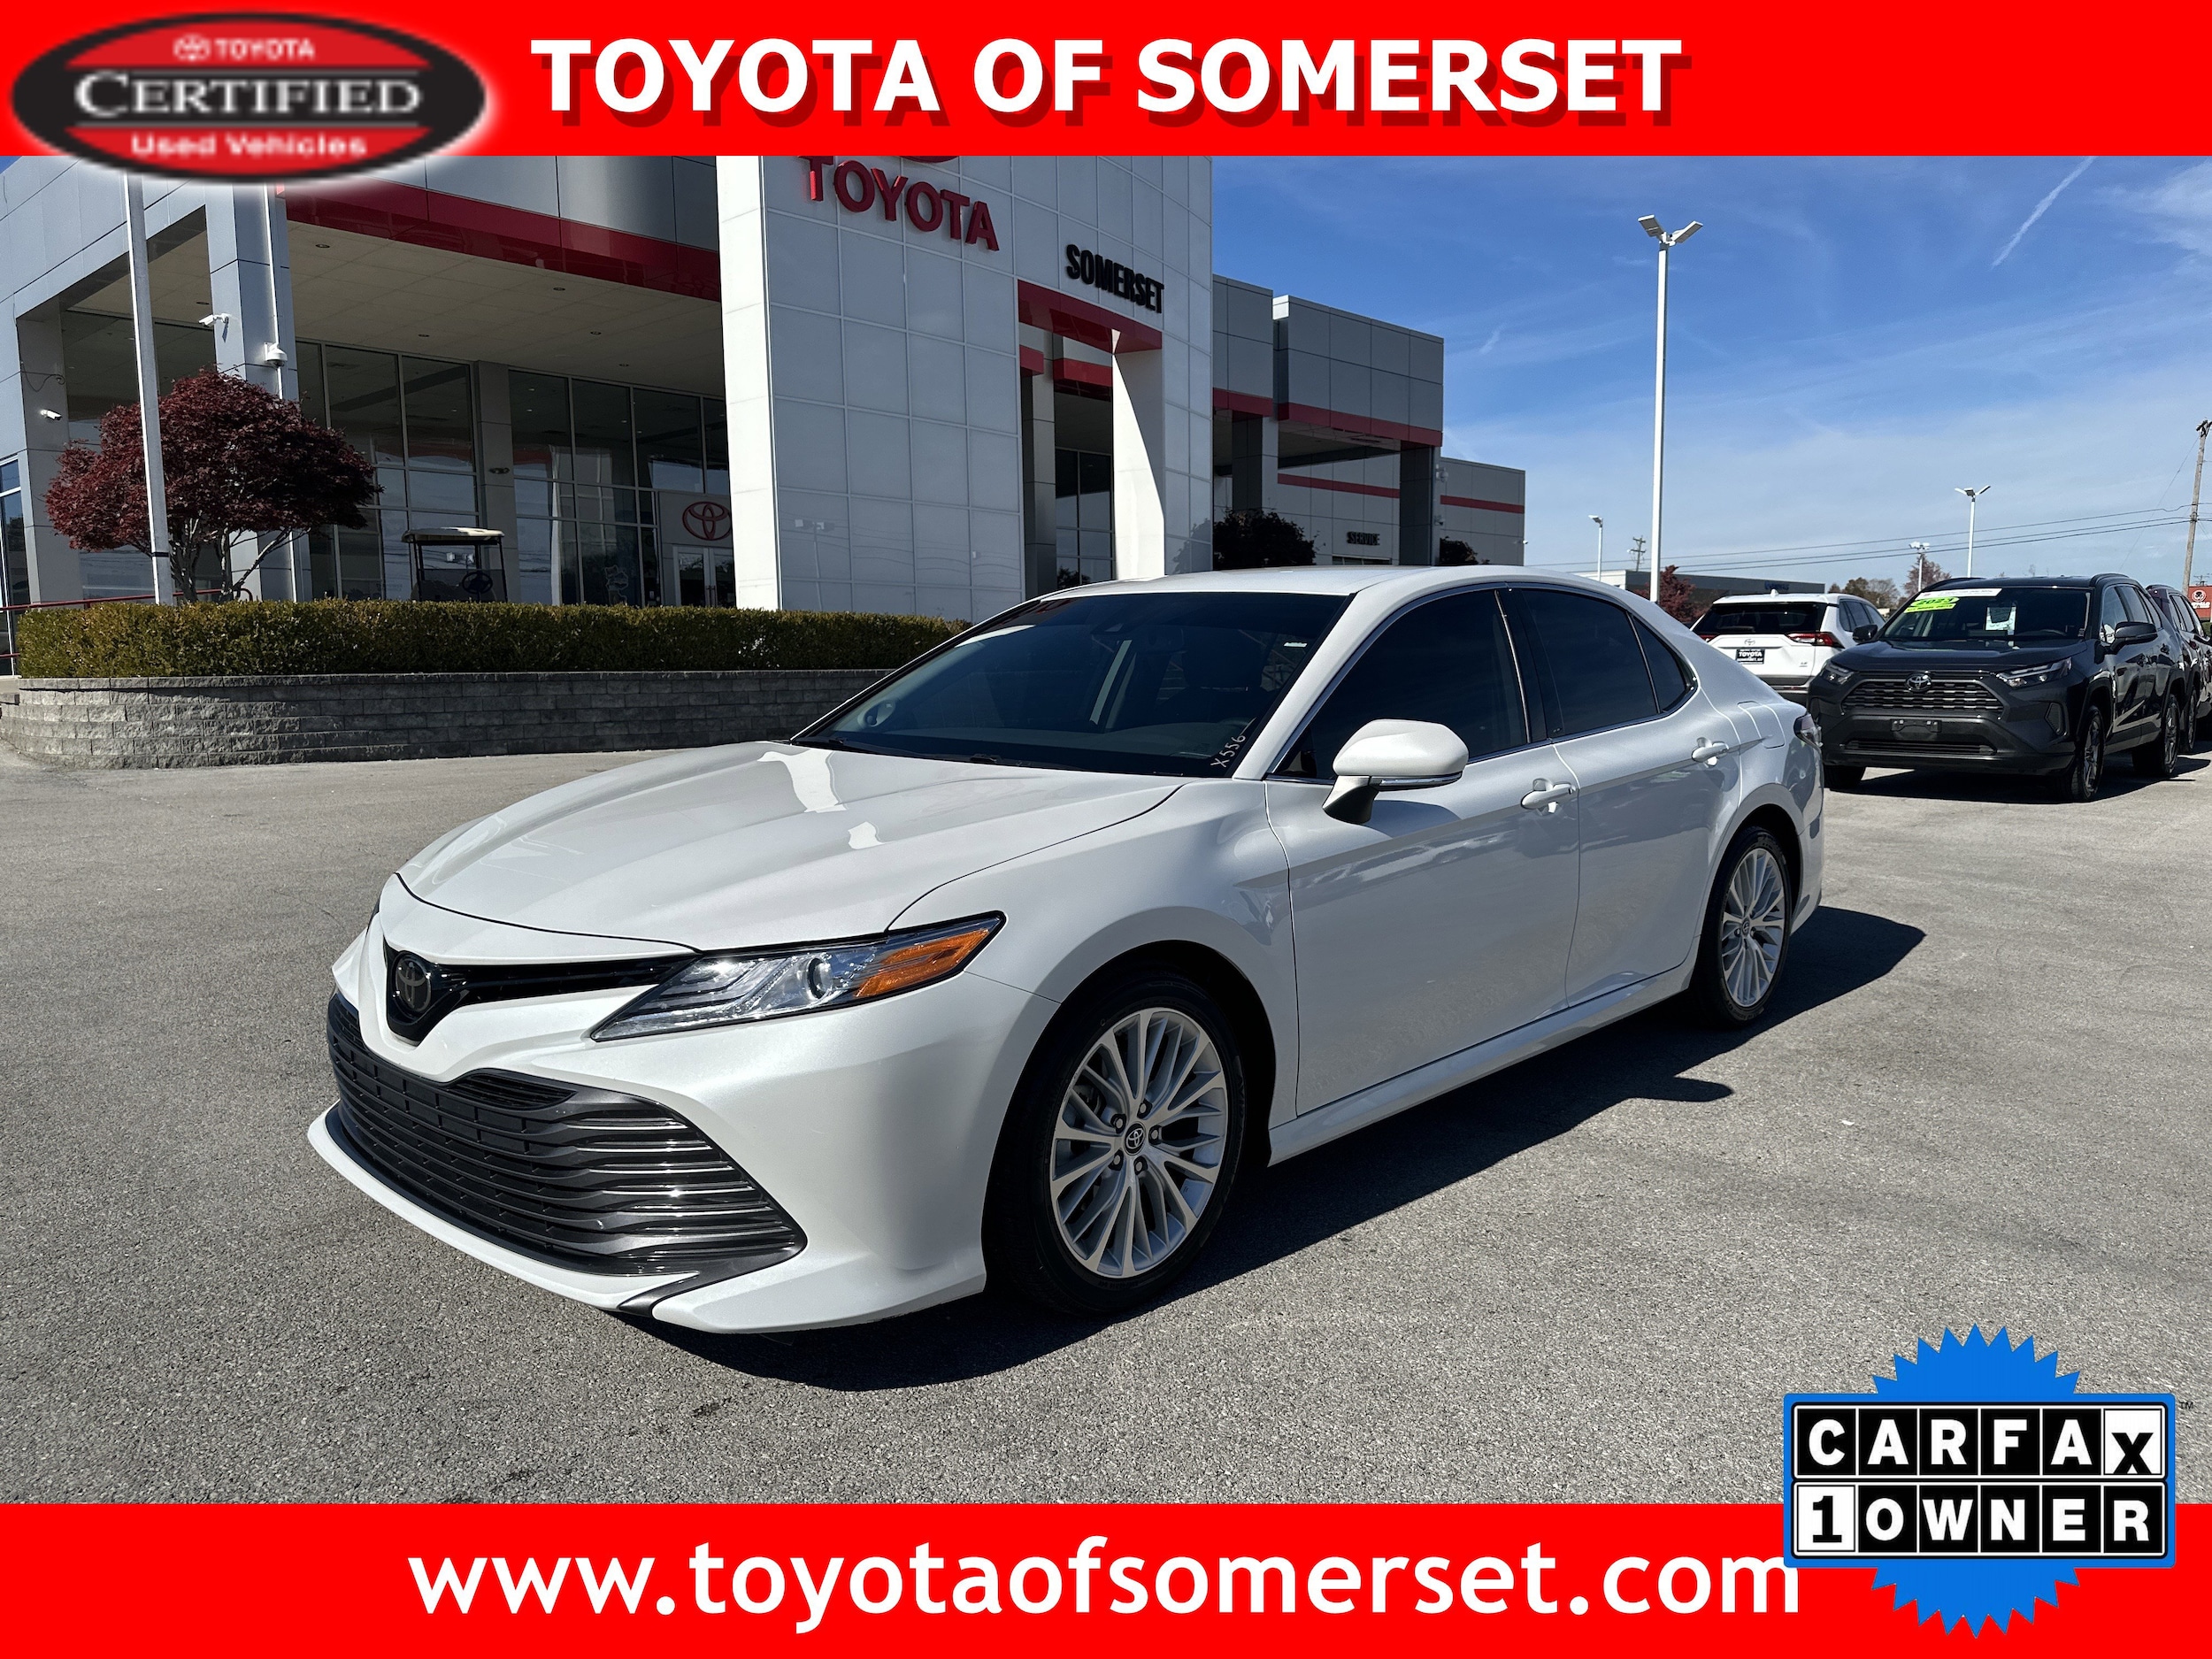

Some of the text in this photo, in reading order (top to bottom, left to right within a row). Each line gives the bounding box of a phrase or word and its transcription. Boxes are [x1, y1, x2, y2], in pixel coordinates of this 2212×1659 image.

[800, 157, 1000, 251] TOYOTA
[1065, 243, 1165, 313] SOMERSET
[1347, 531, 1380, 546] SERVICE
